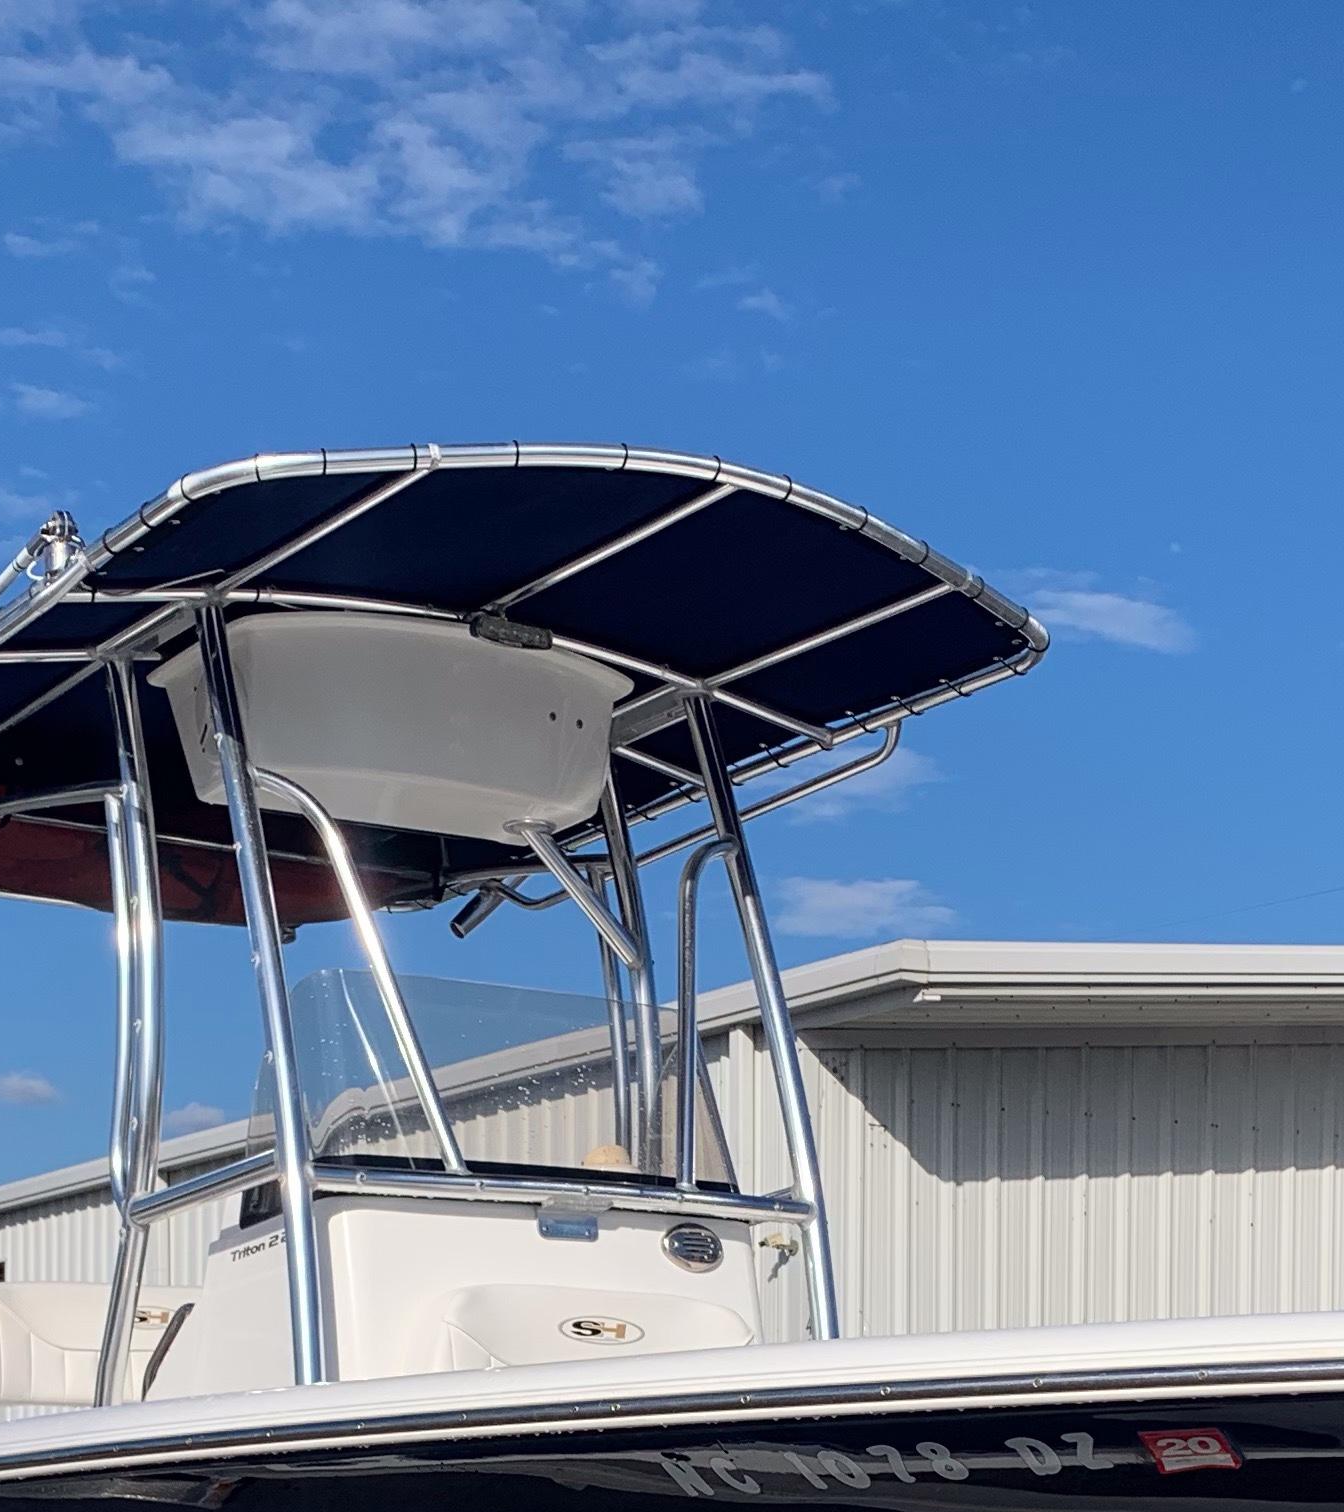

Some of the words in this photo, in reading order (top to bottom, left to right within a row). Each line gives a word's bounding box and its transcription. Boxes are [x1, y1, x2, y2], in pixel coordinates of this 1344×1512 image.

[230, 1242, 266, 1262] Triton
[1156, 1436, 1222, 1456] 20
[660, 1456, 761, 1497] NC
[784, 1441, 970, 1490] 1078
[1004, 1432, 1114, 1476] DZ
